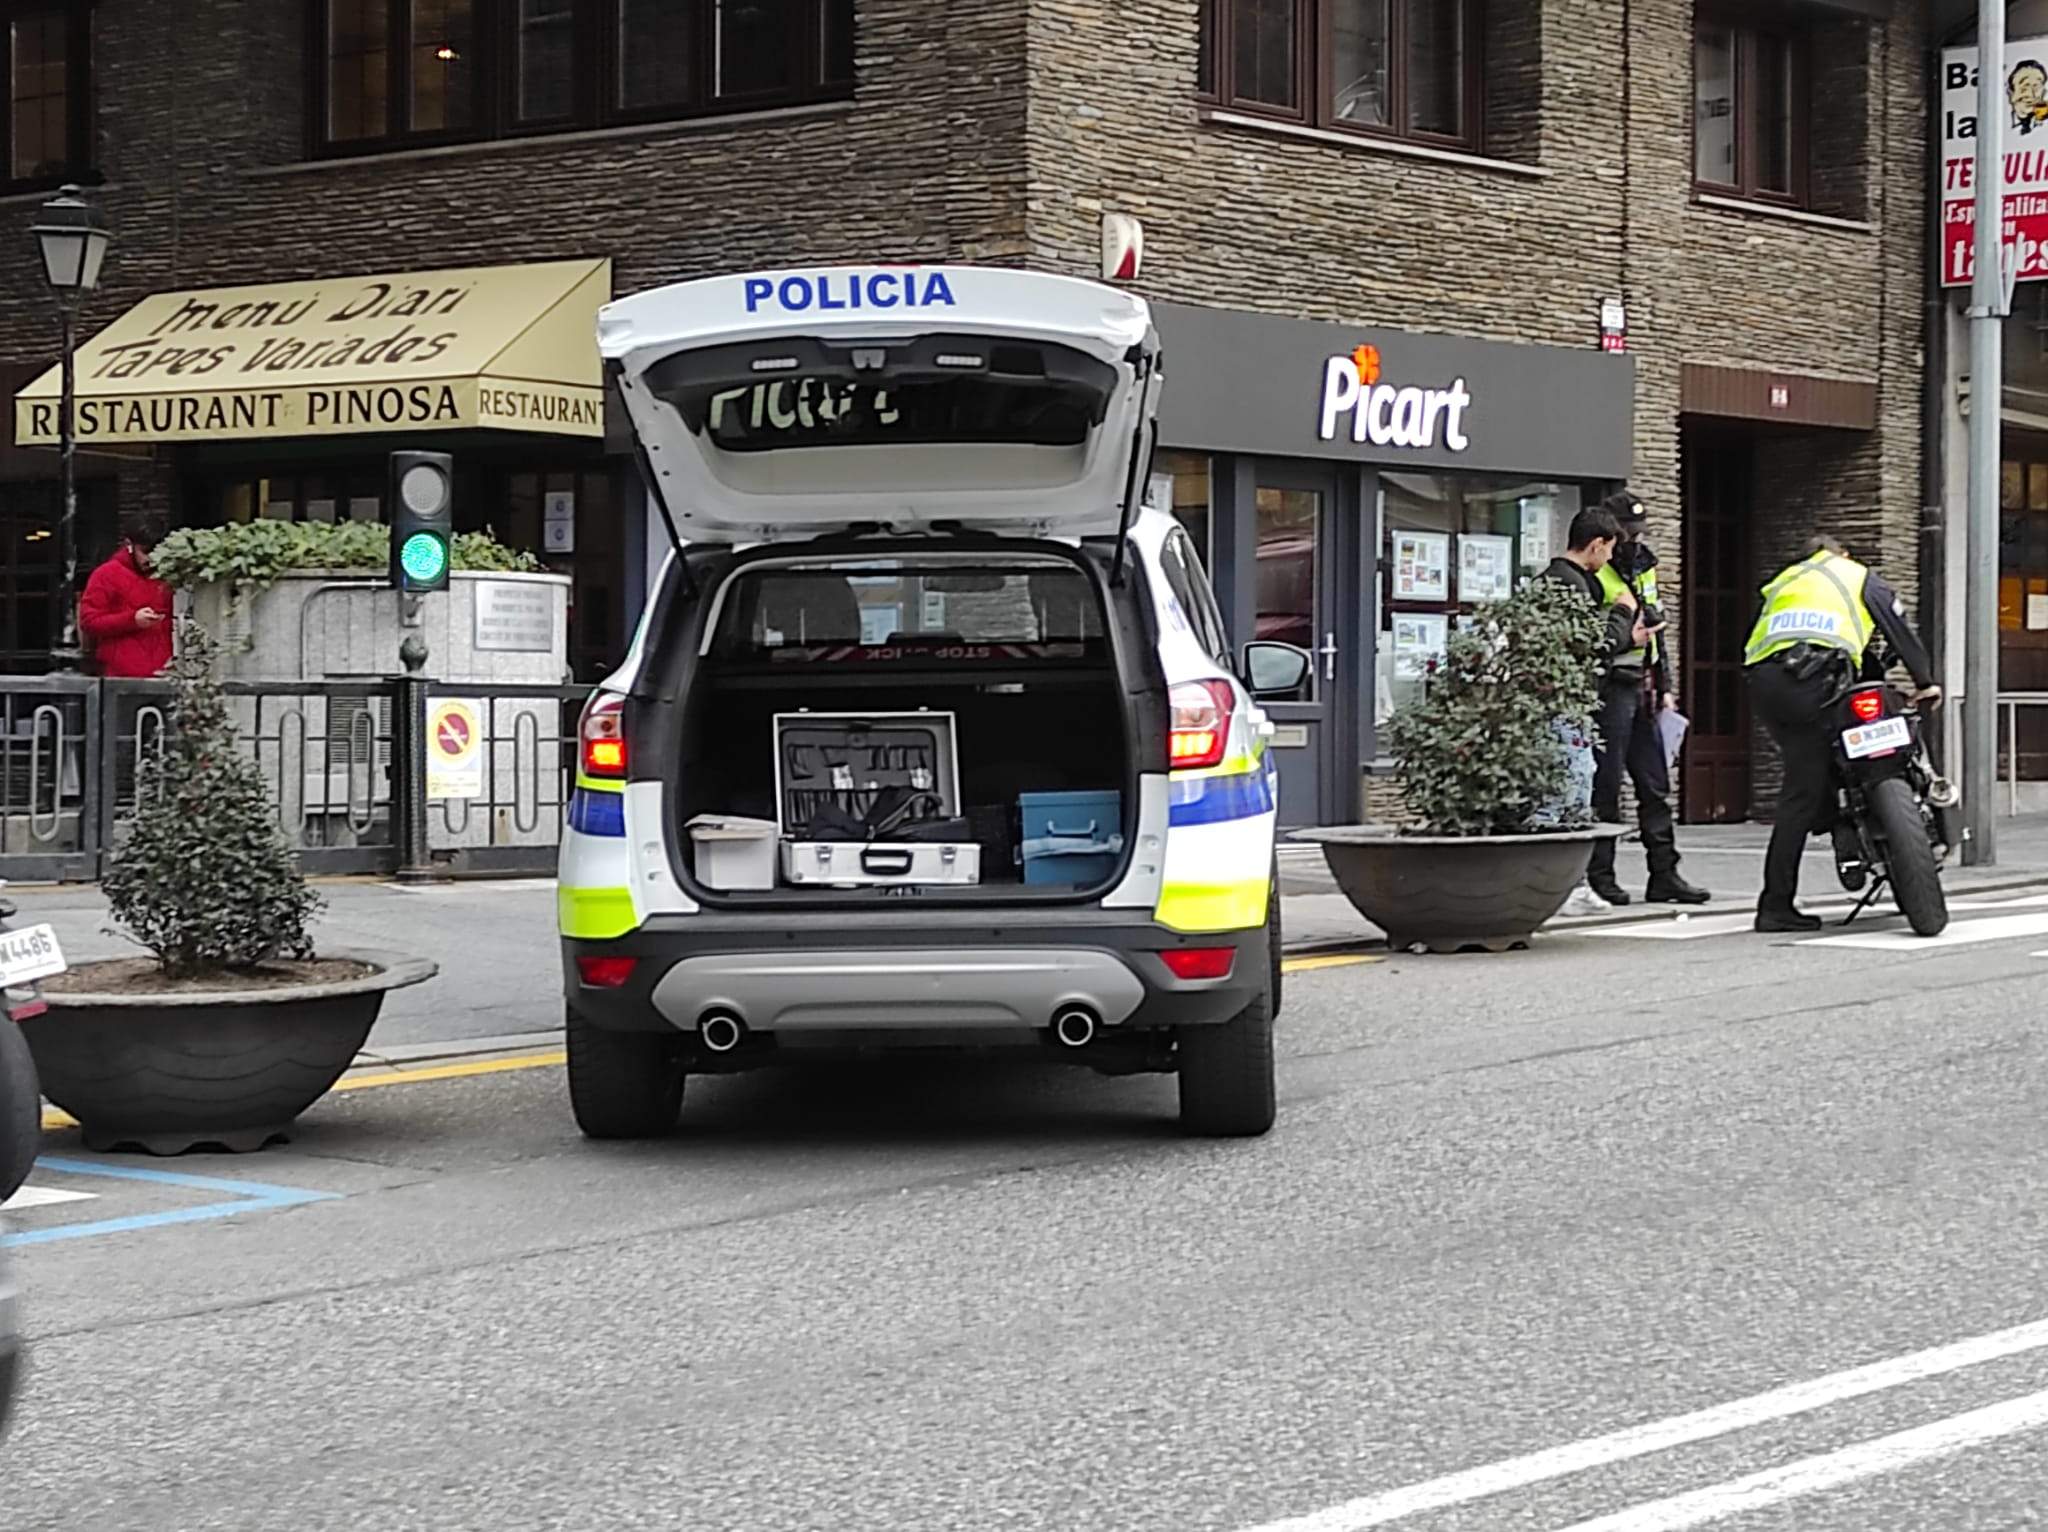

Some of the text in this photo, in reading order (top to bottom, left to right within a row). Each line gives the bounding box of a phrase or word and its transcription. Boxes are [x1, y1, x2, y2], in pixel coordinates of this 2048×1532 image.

[325, 281, 477, 322] Diari
[745, 272, 956, 313] POLICIA
[240, 325, 456, 372] Variades
[306, 385, 460, 425] PINOSA
[1320, 343, 1470, 451] Picart
[1770, 611, 1834, 632] POLICIA
